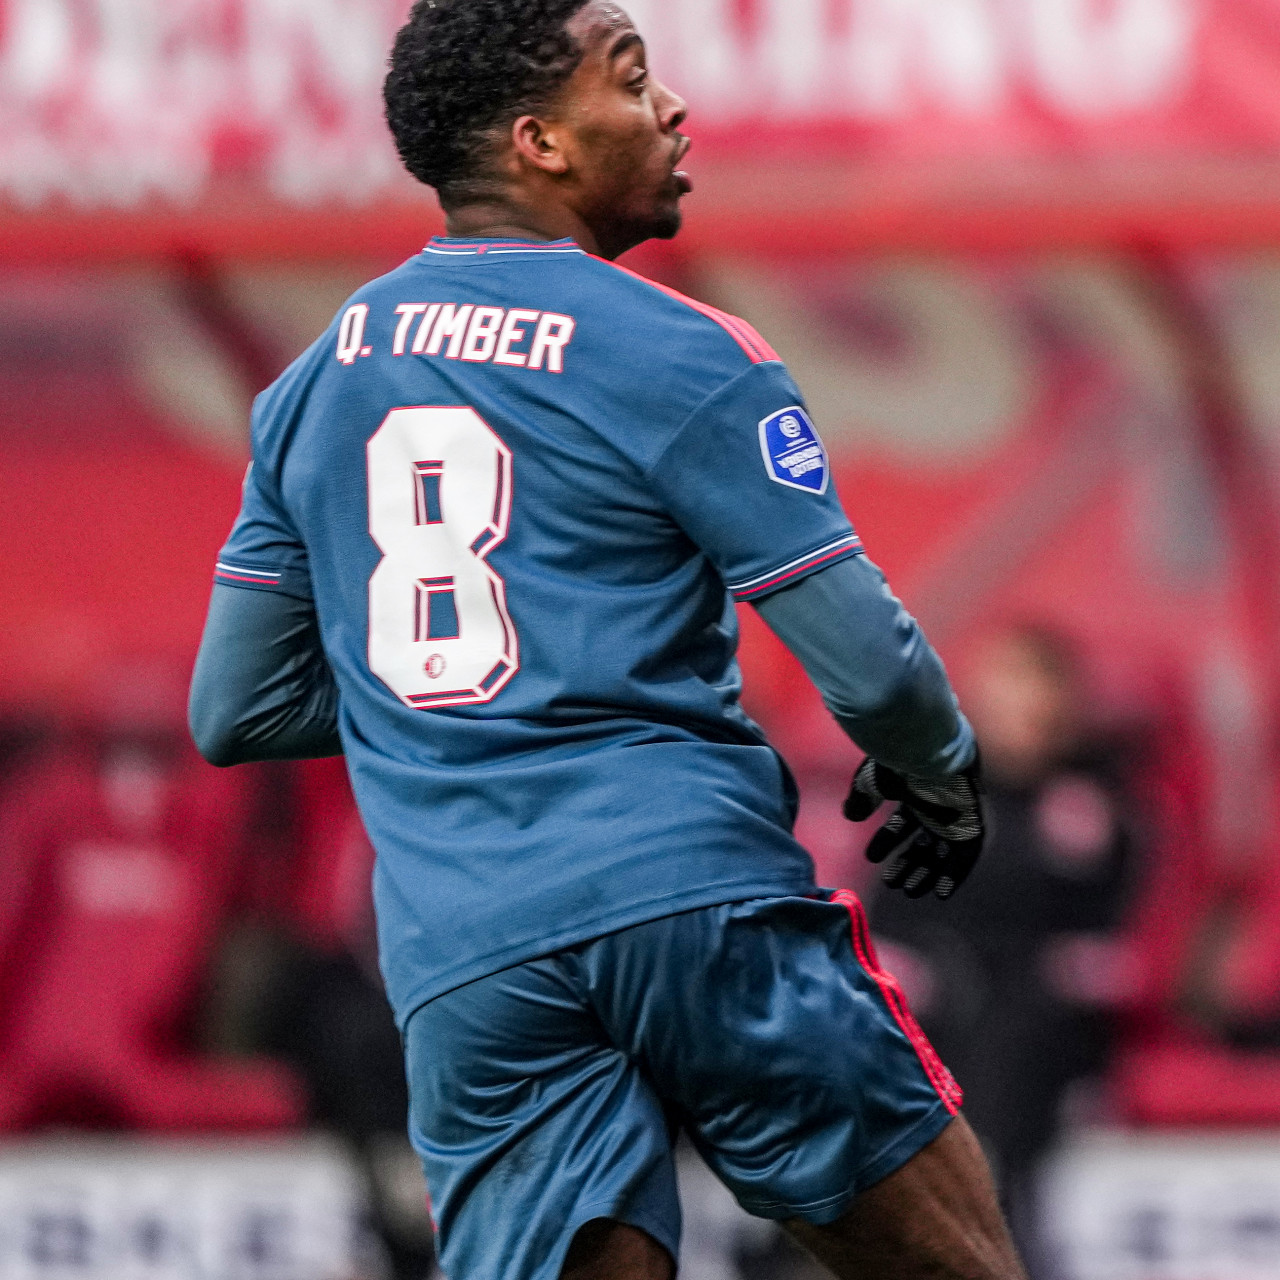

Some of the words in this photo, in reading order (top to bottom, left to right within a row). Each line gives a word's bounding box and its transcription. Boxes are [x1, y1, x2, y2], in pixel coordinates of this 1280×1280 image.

[335, 302, 373, 365] Q.
[391, 302, 577, 374] TIMBER
[365, 405, 520, 709] 8
